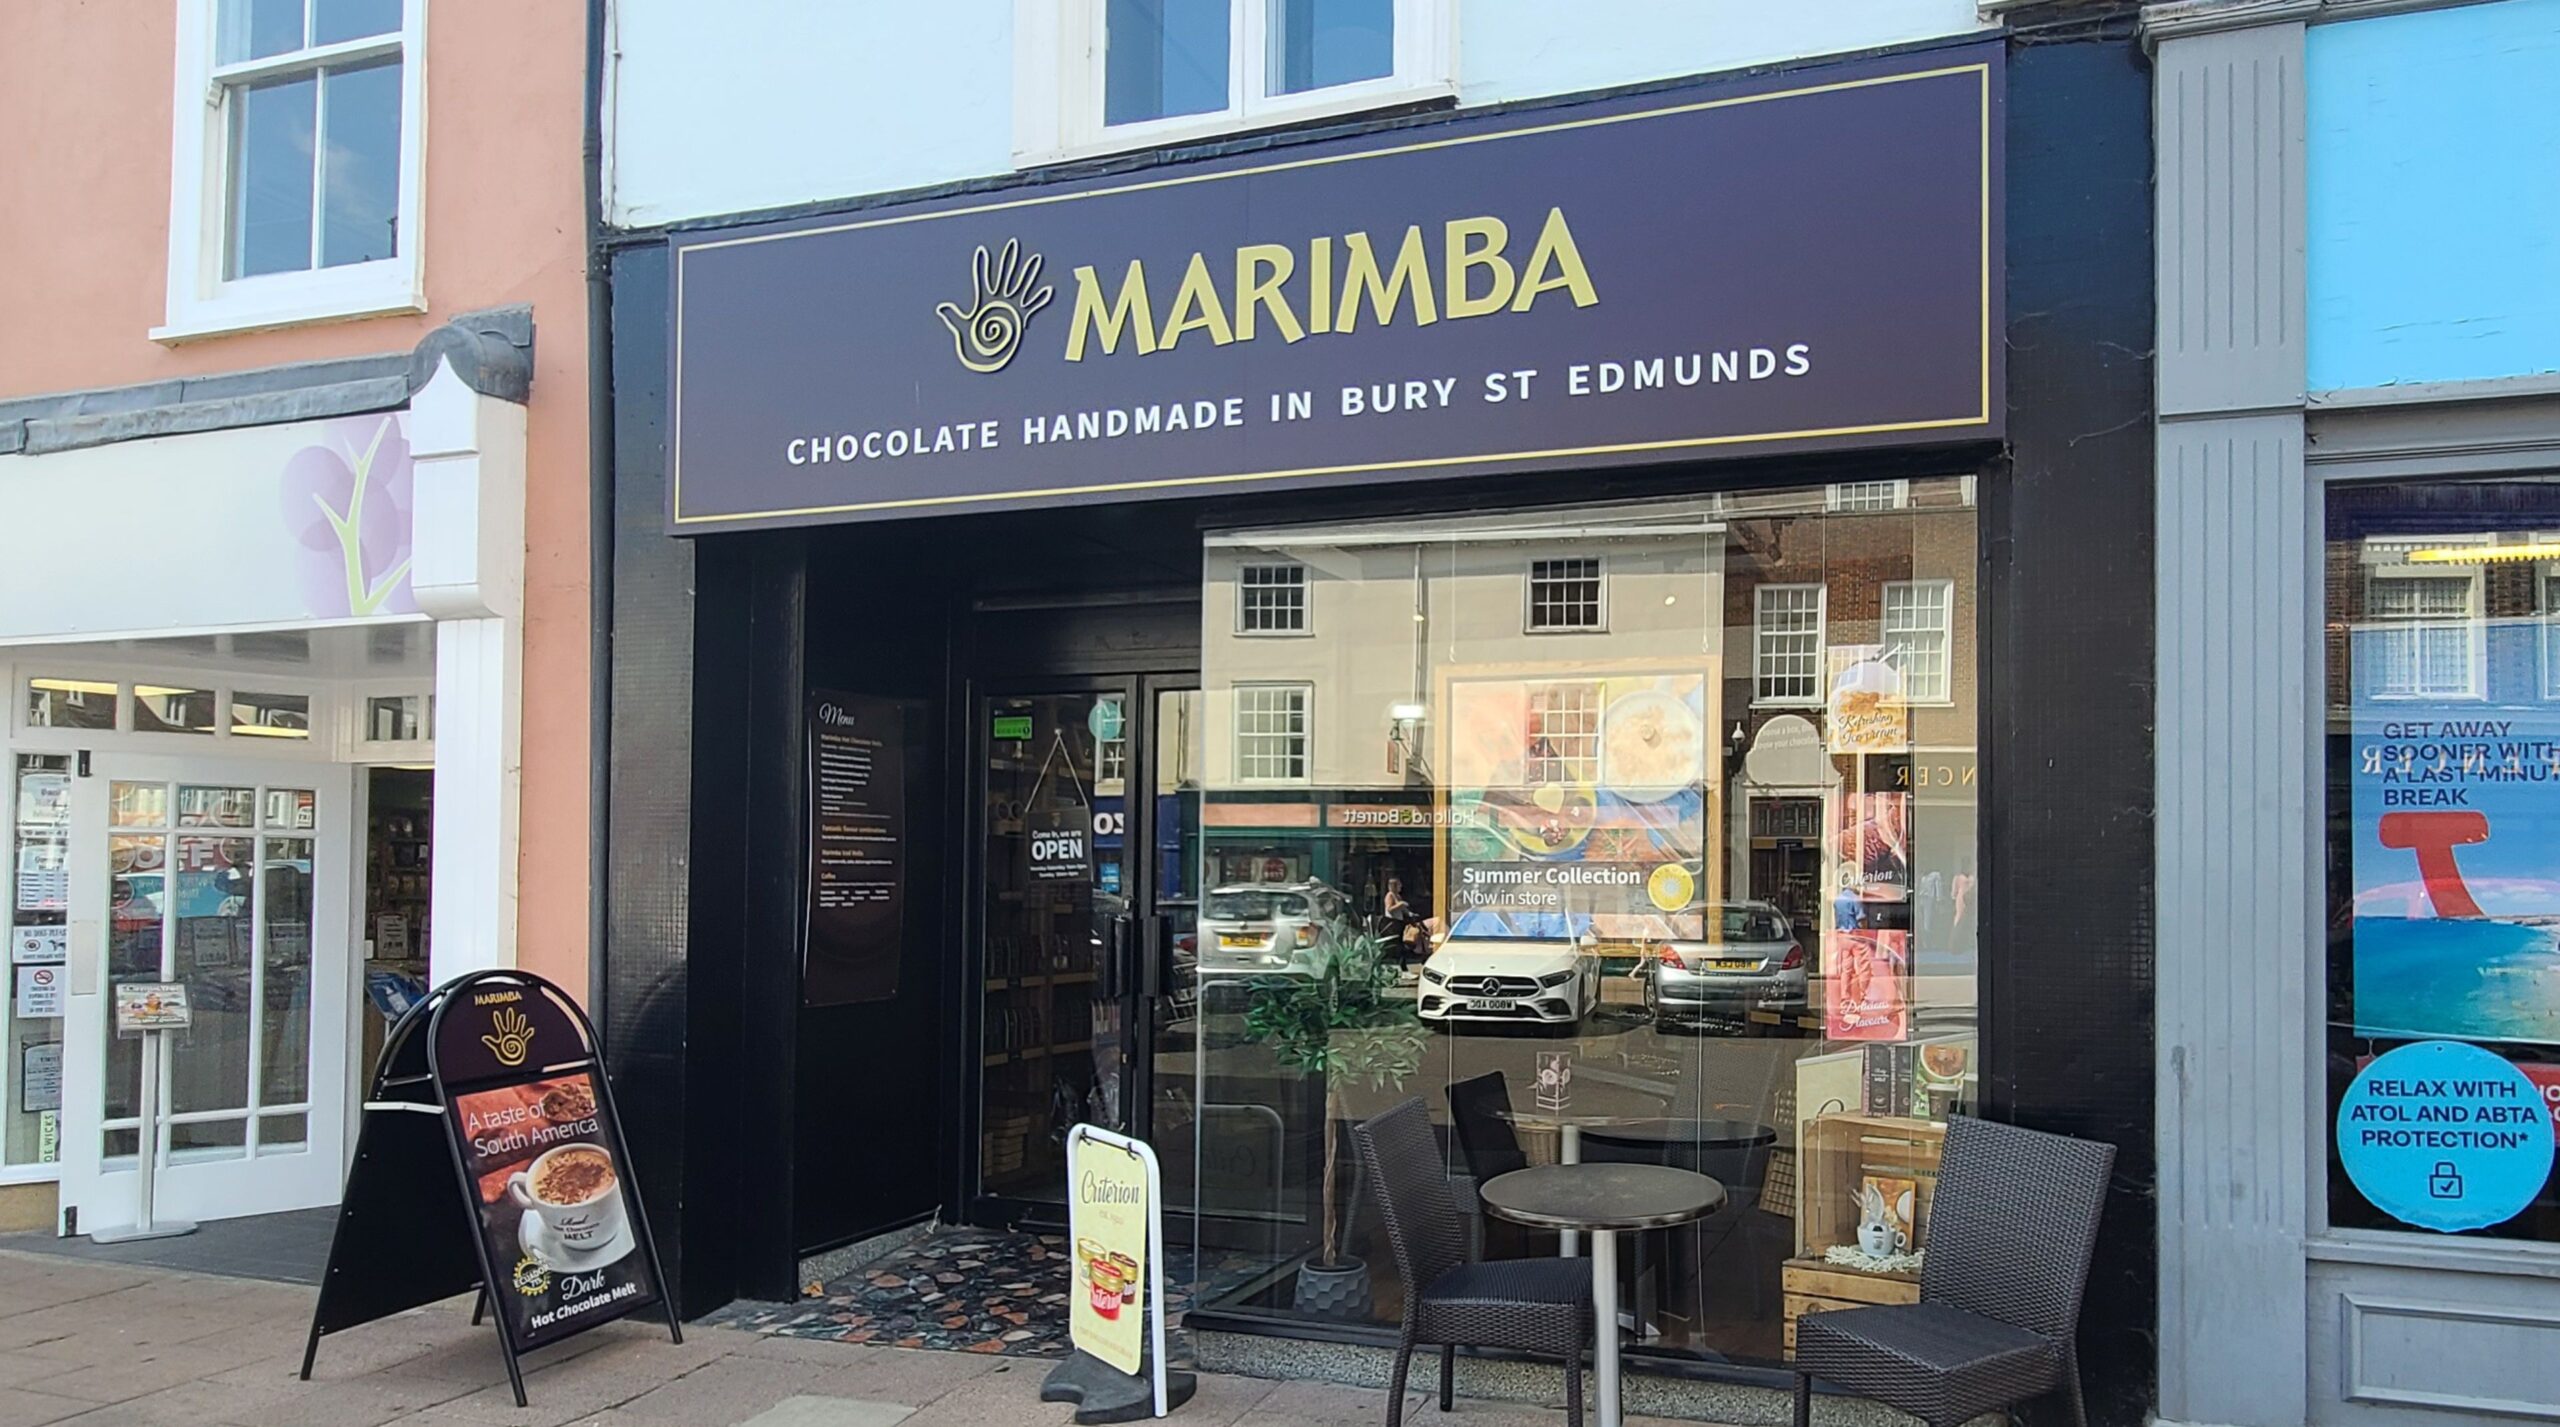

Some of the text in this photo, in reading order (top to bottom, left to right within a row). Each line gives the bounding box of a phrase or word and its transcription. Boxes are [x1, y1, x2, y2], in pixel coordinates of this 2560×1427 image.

[1064, 206, 1600, 362] MARIMBA
[786, 343, 1811, 465] CHOCOLATE HANDMADE IN BURY ST EDMUNDS
[819, 703, 855, 727] Menu
[2383, 721, 2512, 739] GET AWAY
[2383, 743, 2491, 761] SOONER
[2383, 767, 2400, 783] A
[2384, 788, 2468, 806] BREAK
[1032, 838, 1083, 861] OPEN
[1462, 866, 1641, 885] Summer Collection
[1462, 889, 1557, 905] Now in store
[474, 990, 522, 1005] MARIMBA
[2368, 1079, 2517, 1098] RELAX WITH
[469, 1096, 548, 1132] A taste of
[2351, 1105, 2539, 1124] ATOL AND ABTA
[474, 1117, 599, 1158] South America
[1081, 1169, 1140, 1205] Criterion
[563, 1230, 594, 1241] MELT
[561, 1269, 606, 1300] Dark
[531, 1282, 637, 1329] Hot Chocolate Melt
